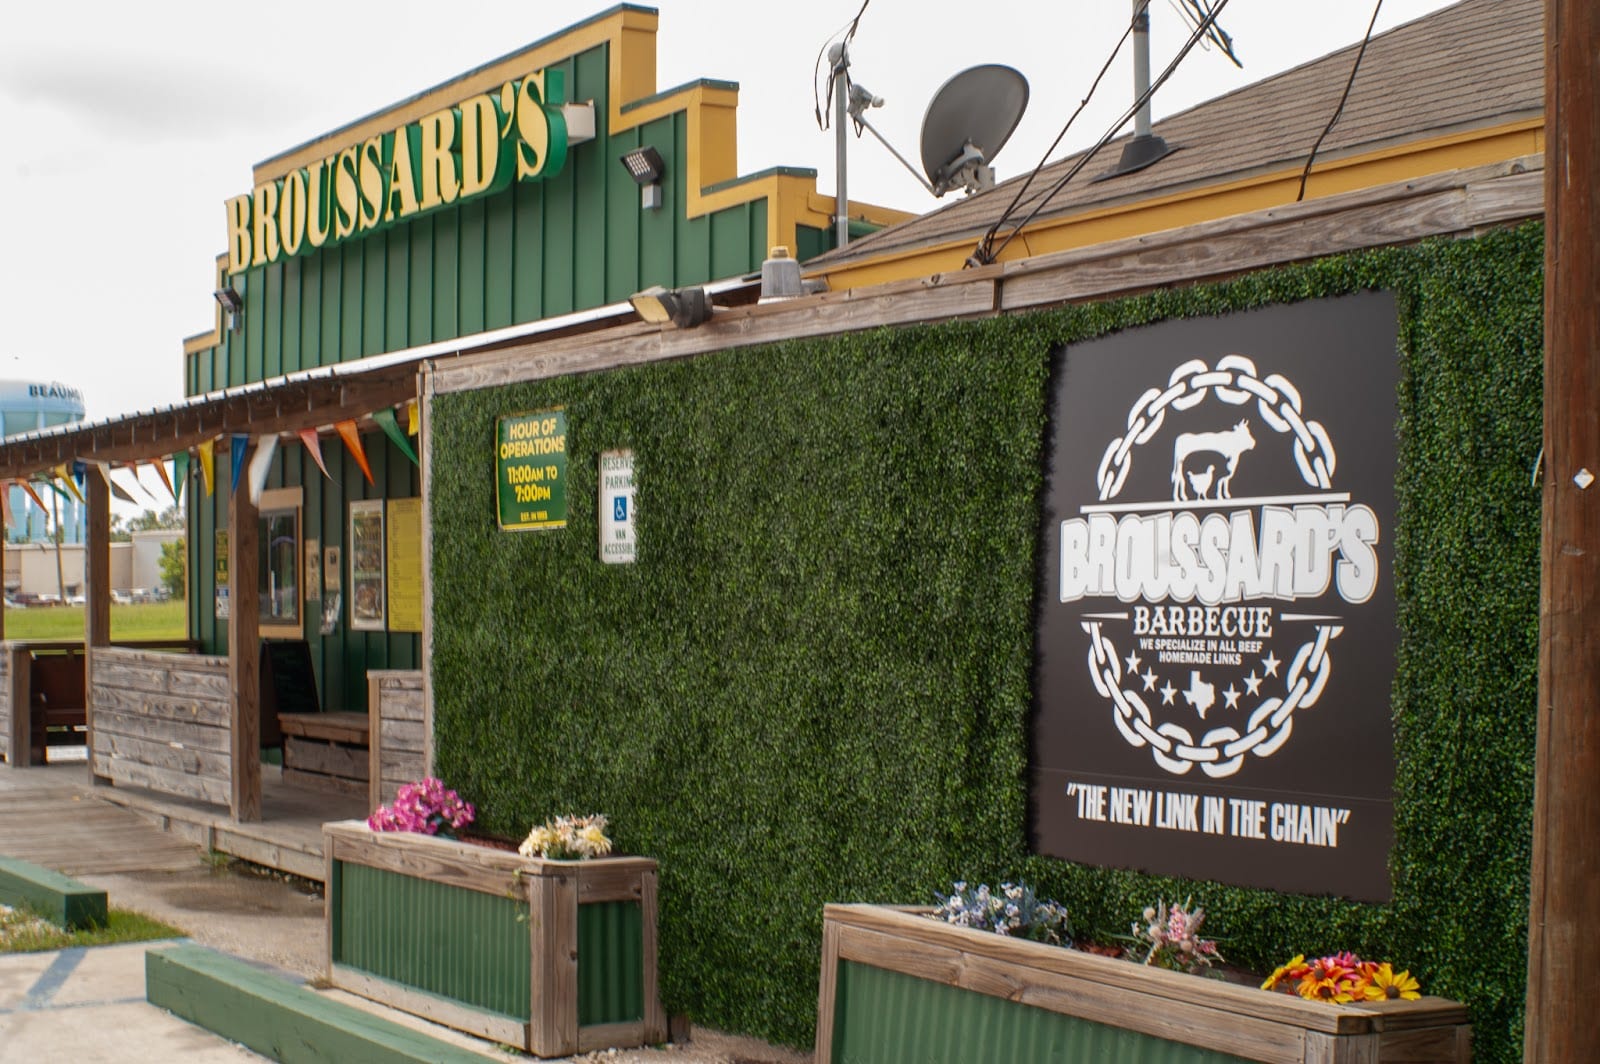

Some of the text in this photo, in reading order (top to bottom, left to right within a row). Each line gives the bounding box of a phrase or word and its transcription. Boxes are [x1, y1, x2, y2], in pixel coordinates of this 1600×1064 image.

[225, 68, 549, 276] BROUSSARD'S
[510, 417, 557, 440] HOUR OF
[500, 435, 567, 460] OPERATIONS
[602, 456, 635, 471] RESERVE
[545, 465, 558, 480] TO
[605, 475, 634, 489] PARKIN
[515, 484, 551, 503] 7:00PM
[615, 528, 626, 540] VAN
[604, 543, 634, 556] ACCESSIBL
[1060, 503, 1379, 605] BROUSSARD'S
[1133, 605, 1272, 638] BARBECUE
[1140, 638, 1263, 653] WE SPECIALIZE IN ALL BEEF
[1159, 651, 1242, 666] HOMEMADE LINKS
[1110, 786, 1152, 827] NEW
[1156, 791, 1199, 832] LINK
[1203, 795, 1225, 835] IN
[1229, 798, 1267, 840] THE
